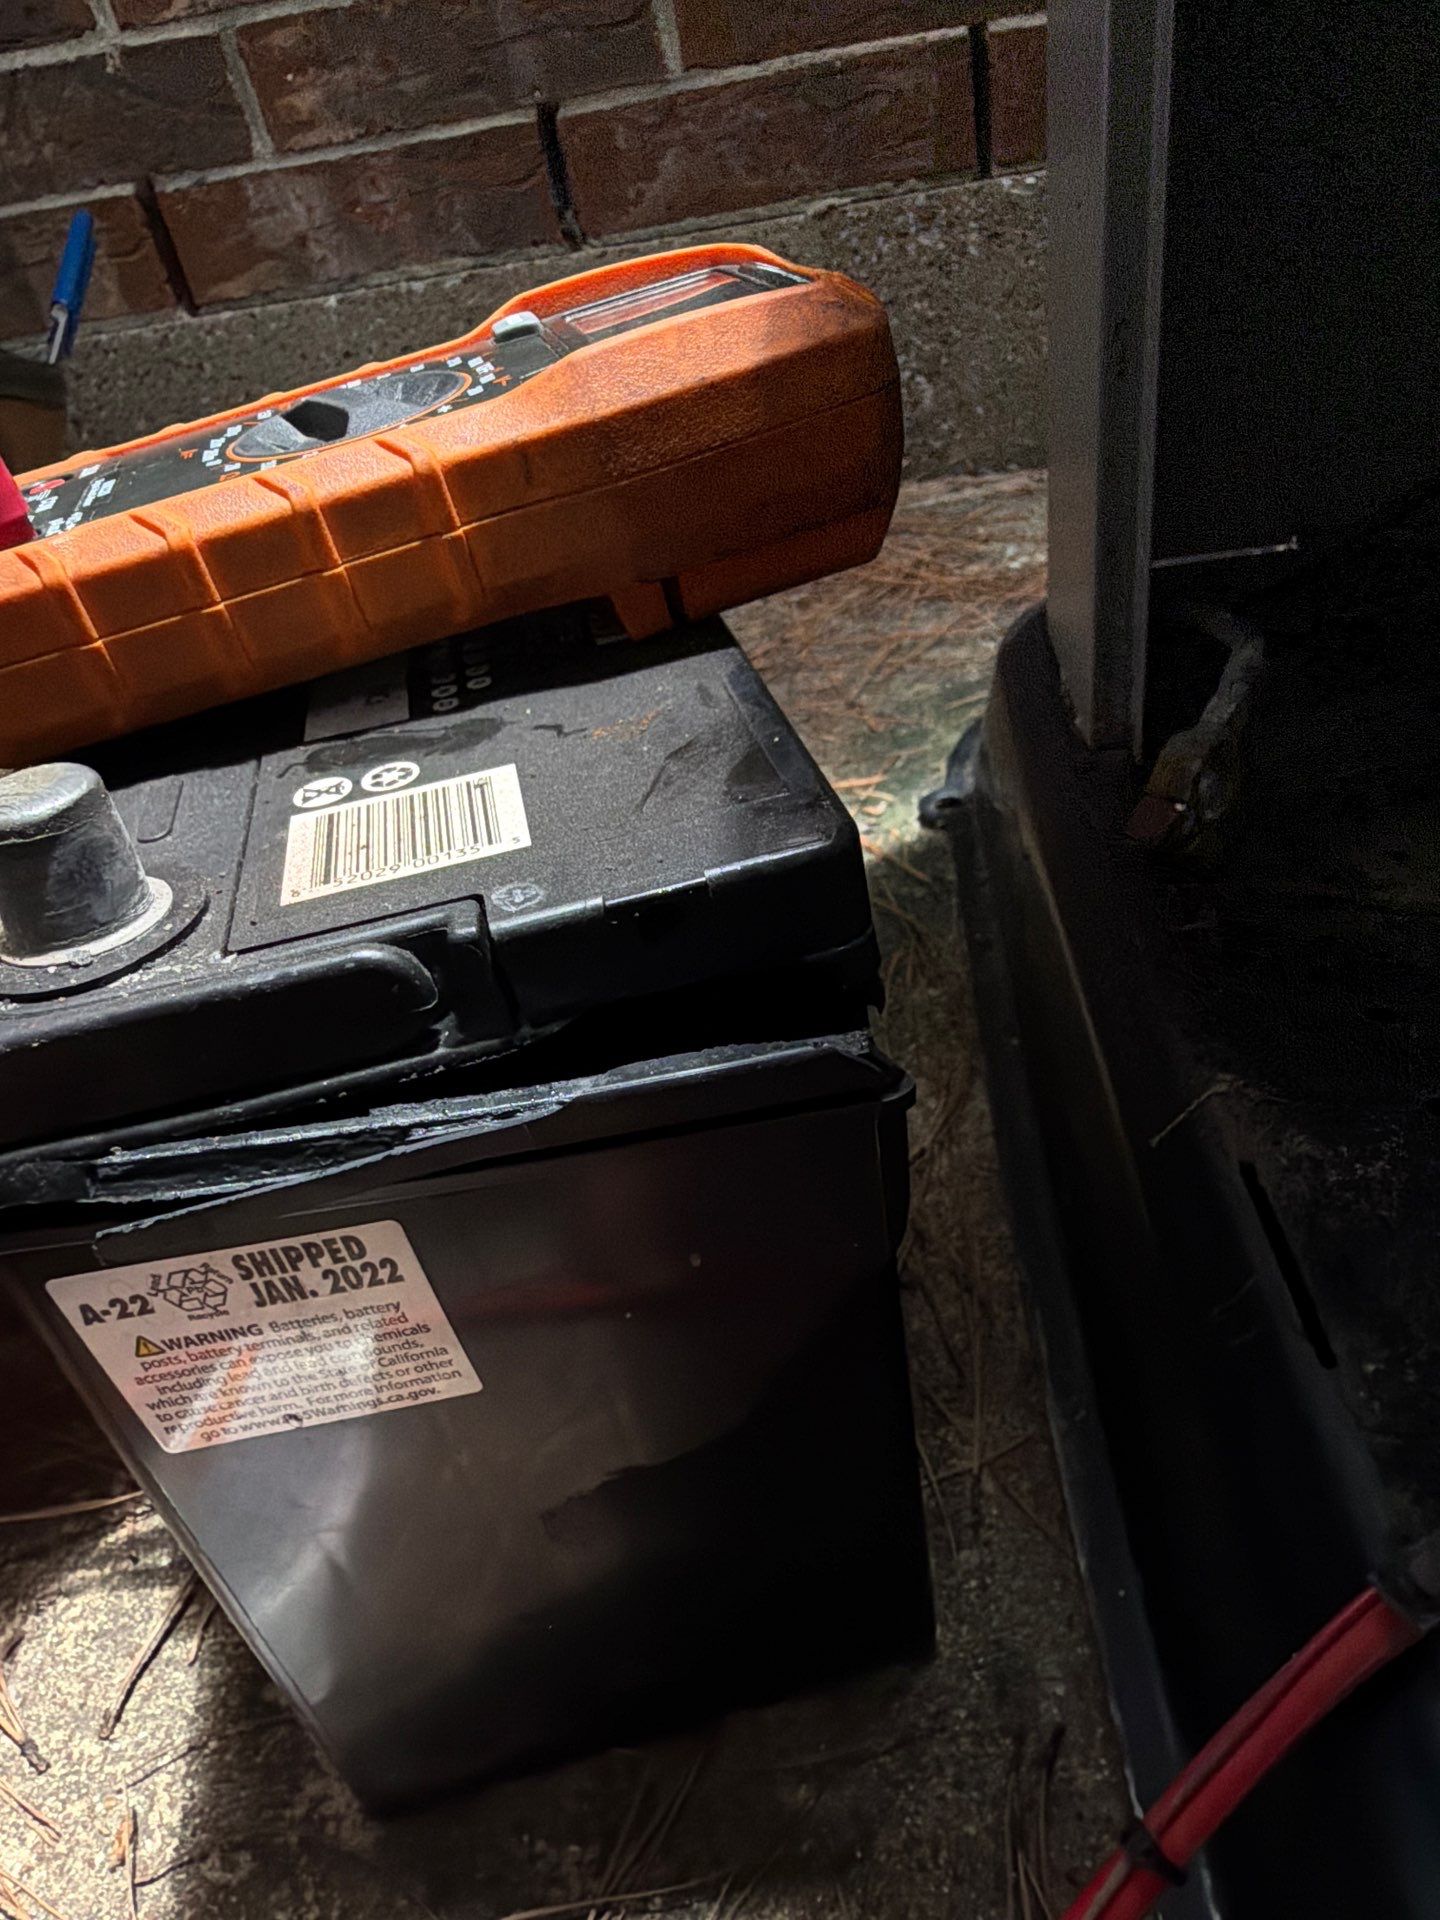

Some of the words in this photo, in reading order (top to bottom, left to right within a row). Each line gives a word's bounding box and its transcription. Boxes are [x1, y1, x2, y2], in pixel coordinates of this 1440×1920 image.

[413, 845, 481, 868] 00135
[231, 1235, 367, 1281] SHIPPED
[249, 1274, 319, 1308] JAN.
[322, 1257, 405, 1296] 2022
[78, 1293, 156, 1327] A-22
[161, 1323, 264, 1352] WARNING
[268, 1313, 343, 1334] Batteries,
[342, 1300, 401, 1320] battery
[134, 1364, 217, 1386] accessories
[219, 1359, 246, 1371] can
[250, 1349, 304, 1365] expose
[304, 1343, 332, 1357] you
[336, 1338, 352, 1349] to
[354, 1322, 431, 1346] chemicals
[140, 1354, 187, 1373] posts,
[187, 1344, 242, 1362] battery
[245, 1331, 321, 1352] terminals,
[323, 1325, 351, 1339] and
[354, 1312, 409, 1334] related
[145, 1394, 194, 1411] which
[219, 1382, 272, 1398] known
[273, 1377, 290, 1389] to
[291, 1371, 317, 1385] the
[377, 1347, 449, 1369] California
[155, 1375, 228, 1396] including
[263, 1363, 293, 1377] and
[155, 1412, 173, 1424] to
[219, 1396, 266, 1411] cancer
[270, 1388, 298, 1401] and
[299, 1380, 337, 1397] birth
[339, 1370, 394, 1389] defects
[395, 1367, 411, 1378] or
[413, 1358, 455, 1375] other
[163, 1409, 257, 1436] reproductive
[259, 1402, 303, 1417] harm.
[306, 1394, 335, 1407] For
[337, 1388, 374, 1403] more
[375, 1370, 463, 1394] information
[200, 1429, 221, 1443] go
[222, 1426, 239, 1437] to
